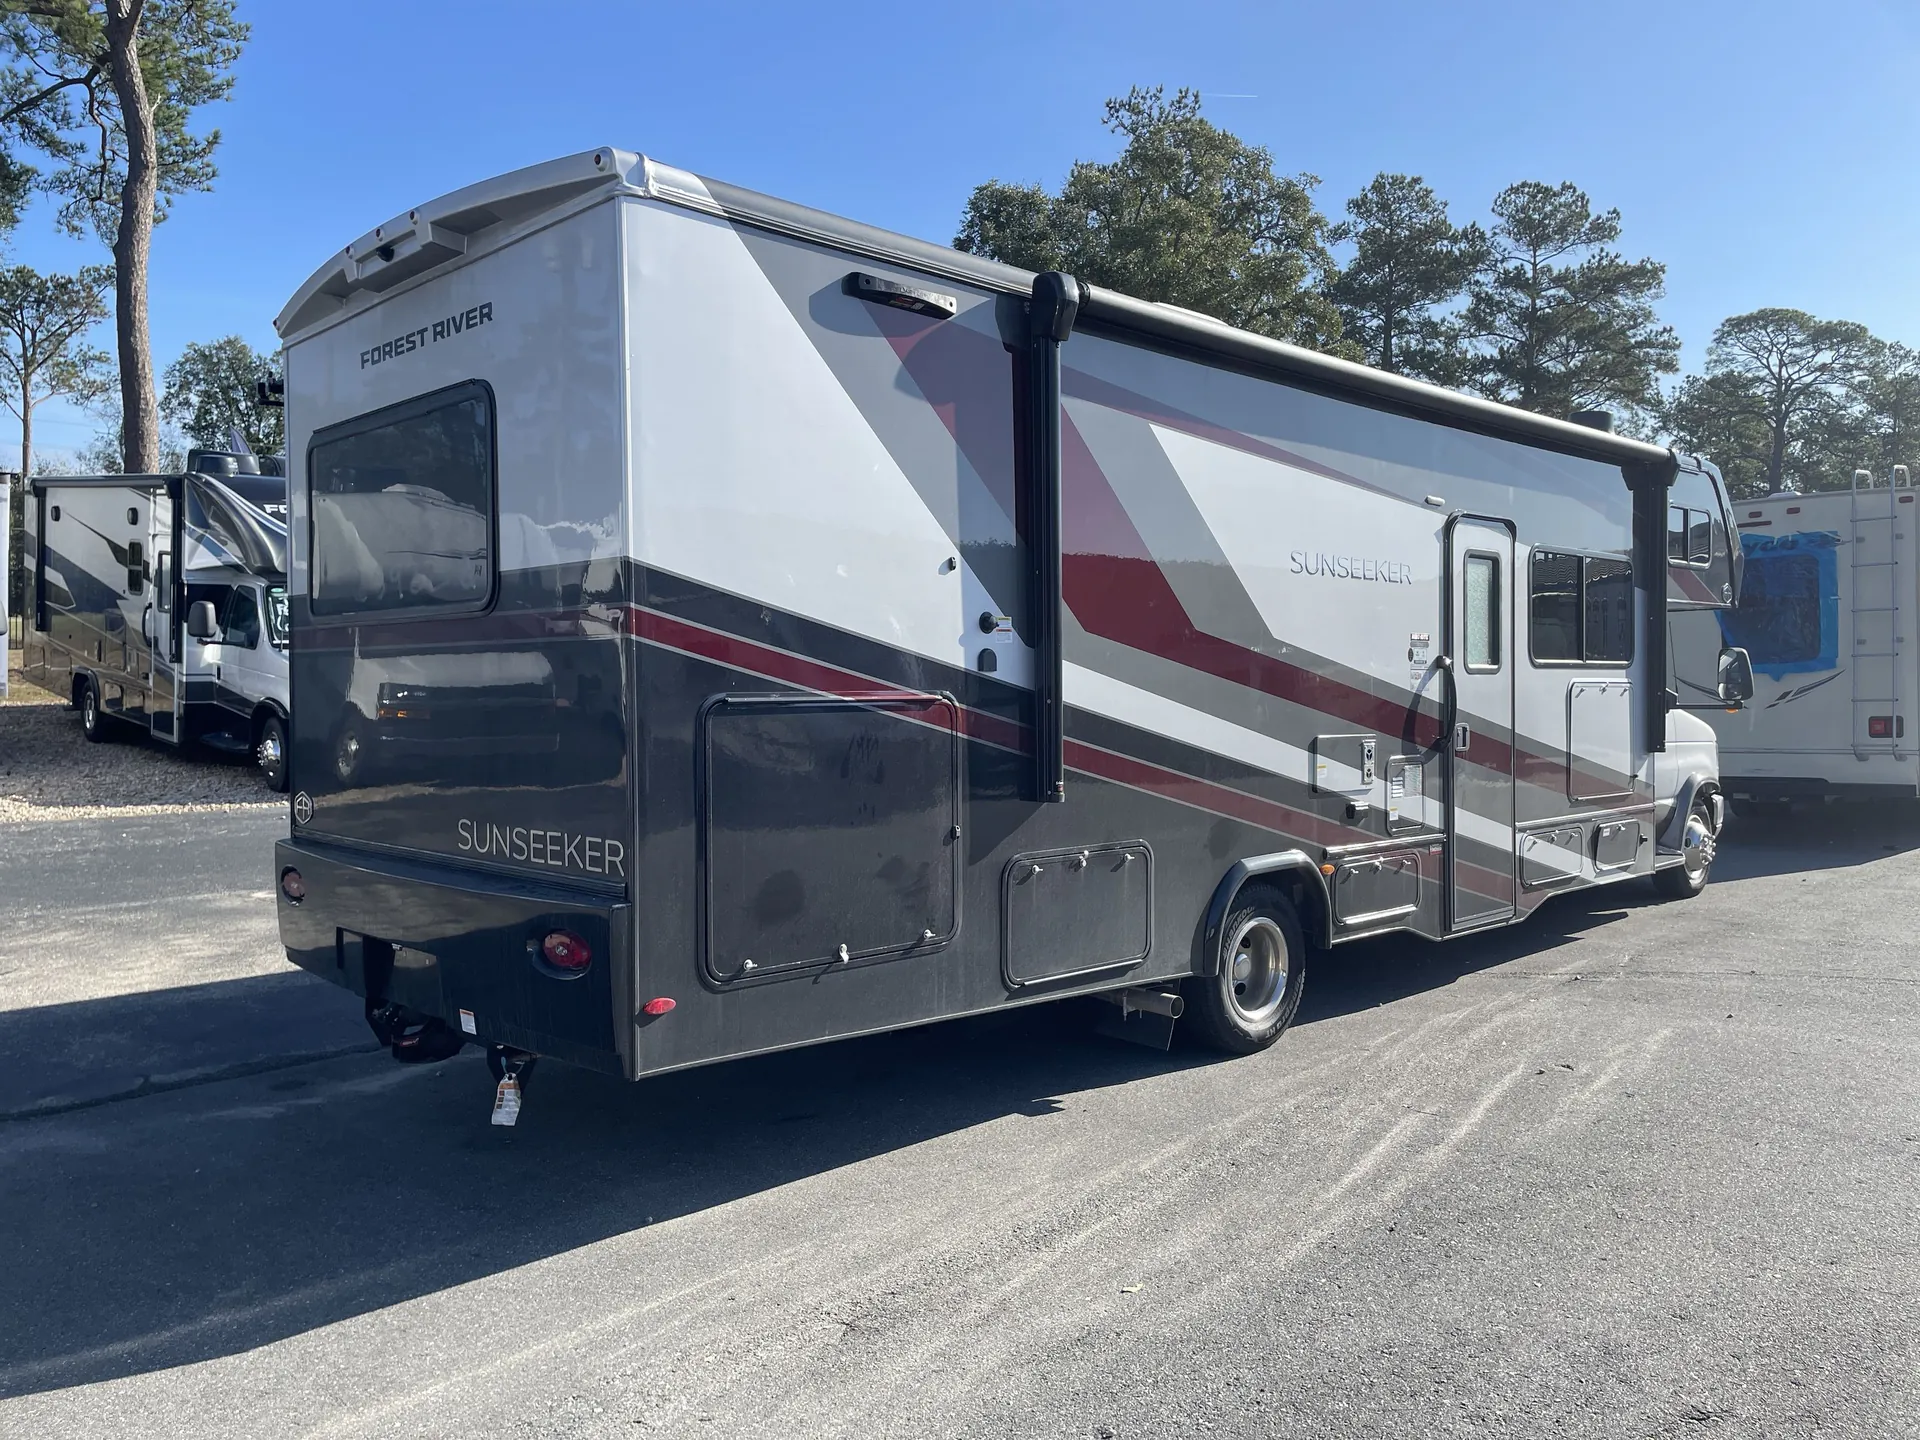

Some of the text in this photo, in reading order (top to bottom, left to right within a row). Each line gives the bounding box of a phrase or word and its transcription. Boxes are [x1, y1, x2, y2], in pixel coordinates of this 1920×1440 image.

[360, 301, 493, 370] FOREST RIVER
[1290, 549, 1412, 585] SUNSEEKER
[457, 818, 625, 877] SUNSEEKER
